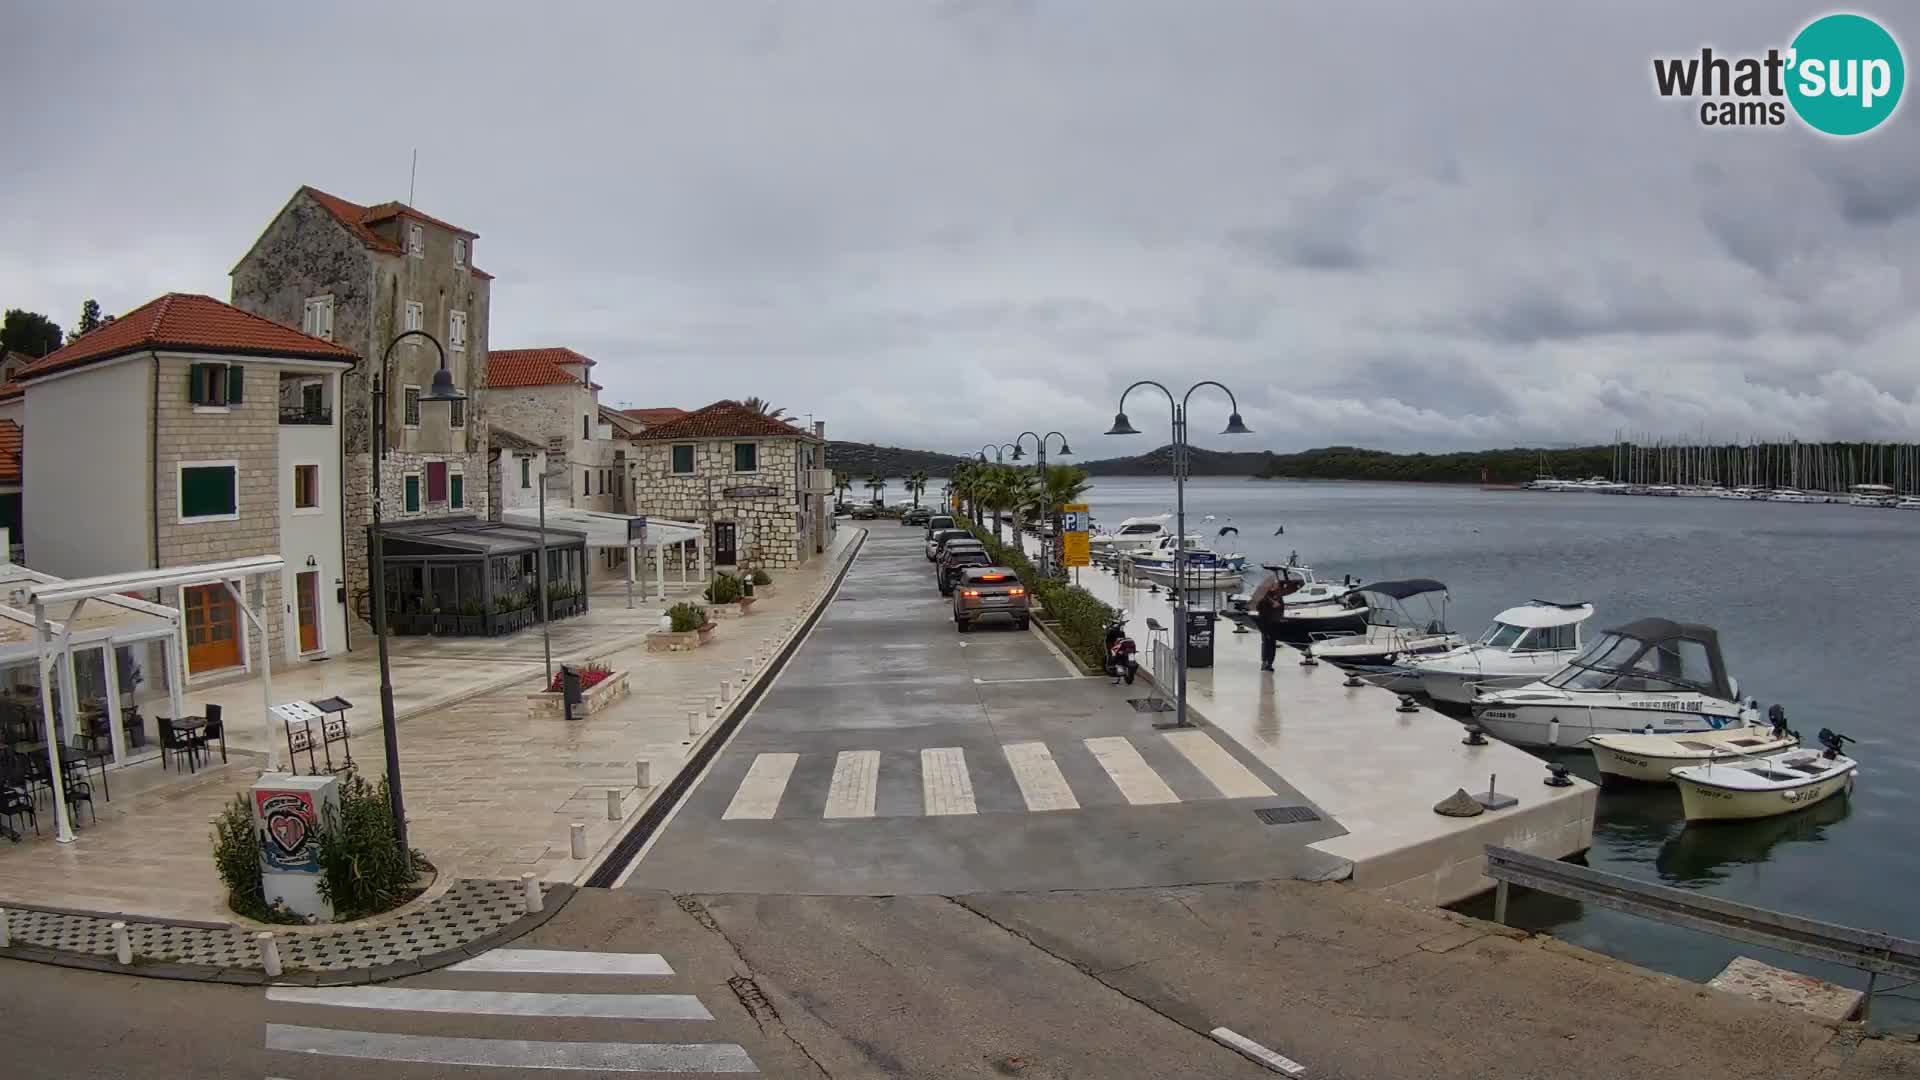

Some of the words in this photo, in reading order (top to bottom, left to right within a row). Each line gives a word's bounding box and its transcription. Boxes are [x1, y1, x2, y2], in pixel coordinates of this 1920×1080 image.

[1065, 514, 1076, 530] P
[1662, 701, 1680, 712] RENT
[1686, 702, 1704, 713] BOAT
